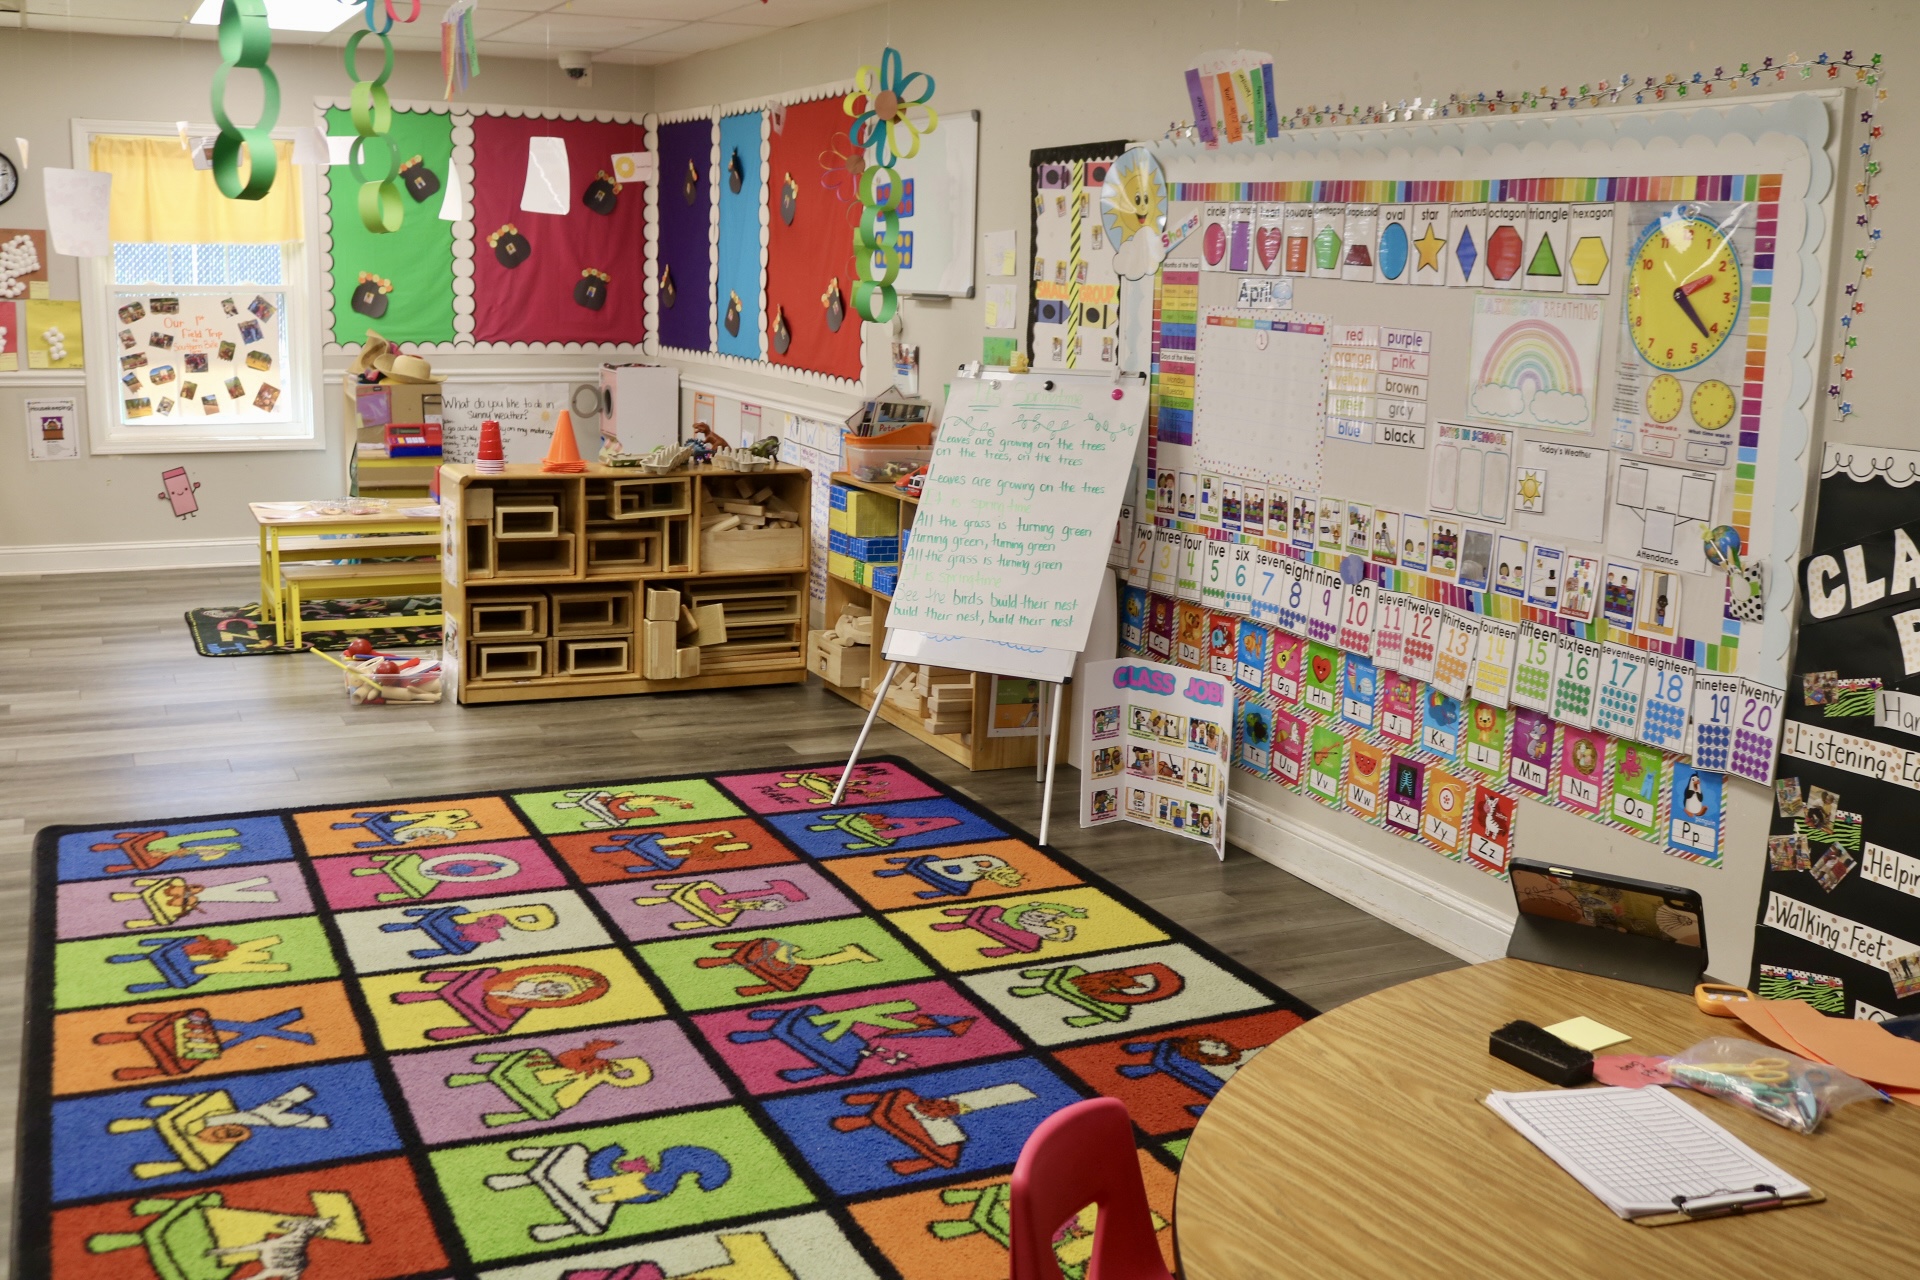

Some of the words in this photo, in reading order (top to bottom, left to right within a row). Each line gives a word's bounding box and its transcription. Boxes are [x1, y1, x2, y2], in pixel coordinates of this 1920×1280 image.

[1206, 206, 1226, 217] circle
[1385, 209, 1406, 221] oval
[1421, 208, 1438, 220] star
[1451, 207, 1487, 218] rhombus
[1489, 207, 1526, 221] octagon
[1530, 208, 1568, 223] triangle
[1573, 208, 1613, 221] hexagon
[1161, 213, 1200, 248] Shapes
[1706, 238, 1712, 250] 1
[1642, 259, 1653, 270] 10
[1719, 261, 1727, 272] 2
[1037, 282, 1070, 300] SMALL
[1080, 285, 1114, 304] GROUP
[1238, 281, 1272, 306] April
[1722, 292, 1730, 304] 3
[1544, 302, 1598, 320] BREATHING
[164, 317, 184, 328] Our
[1710, 322, 1718, 334] 4
[182, 328, 202, 338] Field
[206, 328, 223, 339] Trip
[1346, 328, 1363, 341] red
[1388, 332, 1422, 348] purple
[1334, 352, 1371, 366] orange
[1392, 354, 1415, 370] pink
[1666, 348, 1673, 360] 6
[1386, 378, 1419, 396] brown
[442, 396, 469, 409] What
[474, 398, 485, 408] do
[488, 400, 503, 412] you
[506, 397, 519, 408] like
[524, 397, 533, 408] to
[534, 399, 542, 408] do
[546, 400, 554, 409] in
[468, 410, 492, 421] Sunny
[494, 410, 528, 420] weather?
[879, 423, 895, 432] Pete
[1338, 422, 1360, 438] blue
[1384, 427, 1415, 444] black
[1440, 426, 1459, 439] DAYS
[1462, 428, 1470, 440] IN
[1472, 430, 1506, 445] SCHOOL
[939, 423, 970, 444] Leaves
[975, 437, 992, 446] are
[1000, 438, 1033, 452] growing
[1038, 440, 1050, 448] on
[1058, 438, 1073, 450] the
[1080, 440, 1106, 451] trees
[936, 448, 951, 456] on
[960, 448, 976, 457] the
[984, 449, 1011, 462] trees,
[1018, 452, 1030, 461] on
[1035, 452, 1051, 462] the
[1059, 453, 1083, 466] trees
[1539, 445, 1563, 456] Today's
[1565, 447, 1592, 458] Weather
[916, 511, 933, 526] All
[938, 514, 957, 528] the
[964, 520, 991, 535] grass
[998, 518, 1007, 530] is
[1018, 517, 1054, 540] turning
[1062, 525, 1092, 542] green
[1137, 528, 1153, 540] two
[912, 528, 948, 551] turning
[953, 538, 989, 552] green,
[992, 533, 1024, 556] turning
[1028, 542, 1056, 556] green
[1156, 529, 1180, 544] three
[1184, 535, 1202, 550] four
[1137, 541, 1146, 563] 2
[1208, 542, 1226, 557] five
[1236, 547, 1250, 561] six
[1636, 550, 1679, 566] Attendance
[1257, 552, 1285, 568] seven
[1211, 560, 1219, 582] 5
[1236, 565, 1246, 586] 6
[1285, 561, 1313, 581] eight
[1807, 528, 1920, 619] CLA
[1262, 572, 1274, 596] 7
[1317, 572, 1341, 590] nine
[1352, 583, 1370, 598] ten
[896, 583, 919, 602] See
[925, 587, 945, 604] the
[953, 588, 984, 606] birds
[990, 592, 1018, 608] build
[1020, 595, 1050, 610] their
[1055, 598, 1079, 611] nest
[1289, 582, 1302, 608] 8
[1323, 590, 1331, 616] 9
[894, 601, 918, 616] build
[924, 606, 953, 621] their
[956, 610, 984, 626] nest,
[989, 611, 1015, 625] build
[1019, 613, 1045, 627] their
[1051, 616, 1074, 628] nest
[1346, 596, 1368, 626] 10
[1408, 598, 1441, 619] twelve
[1412, 613, 1432, 640] 12
[1443, 611, 1478, 637] thirteen
[1480, 621, 1516, 640] fourteen
[1520, 620, 1557, 643] fifteen
[1446, 629, 1469, 657] 13
[1526, 638, 1548, 665] 15
[1559, 638, 1599, 658] sixteen
[1184, 646, 1195, 660] Dd
[1603, 645, 1646, 664] seventeen
[1216, 657, 1227, 672] Ee
[1565, 652, 1588, 680] 16
[1609, 658, 1638, 688] 17
[1648, 656, 1694, 676] eighteen
[1114, 666, 1175, 694] CLASS
[1278, 677, 1290, 696] Gg
[1655, 671, 1683, 702] 18
[1696, 679, 1737, 693] ninetee
[1313, 688, 1327, 705] Hh
[1740, 680, 1782, 708] twenty
[1352, 701, 1362, 716] Ii
[1710, 694, 1730, 724] 19
[1742, 699, 1772, 731] 20
[1431, 729, 1445, 747] Kk
[1794, 724, 1887, 780] Listening
[1519, 762, 1541, 784] Mm
[1353, 789, 1371, 806] Ww
[1570, 781, 1590, 801] Nn
[1395, 804, 1411, 822] Xx
[1624, 798, 1643, 819] Oo
[1433, 818, 1448, 840] Yy
[1682, 822, 1700, 845] Pp
[1478, 838, 1496, 858] Zz
[418, 852, 519, 883] O
[1774, 894, 1840, 950] Walking
[1849, 926, 1886, 962] Feet
[212, 1006, 315, 1050] X
